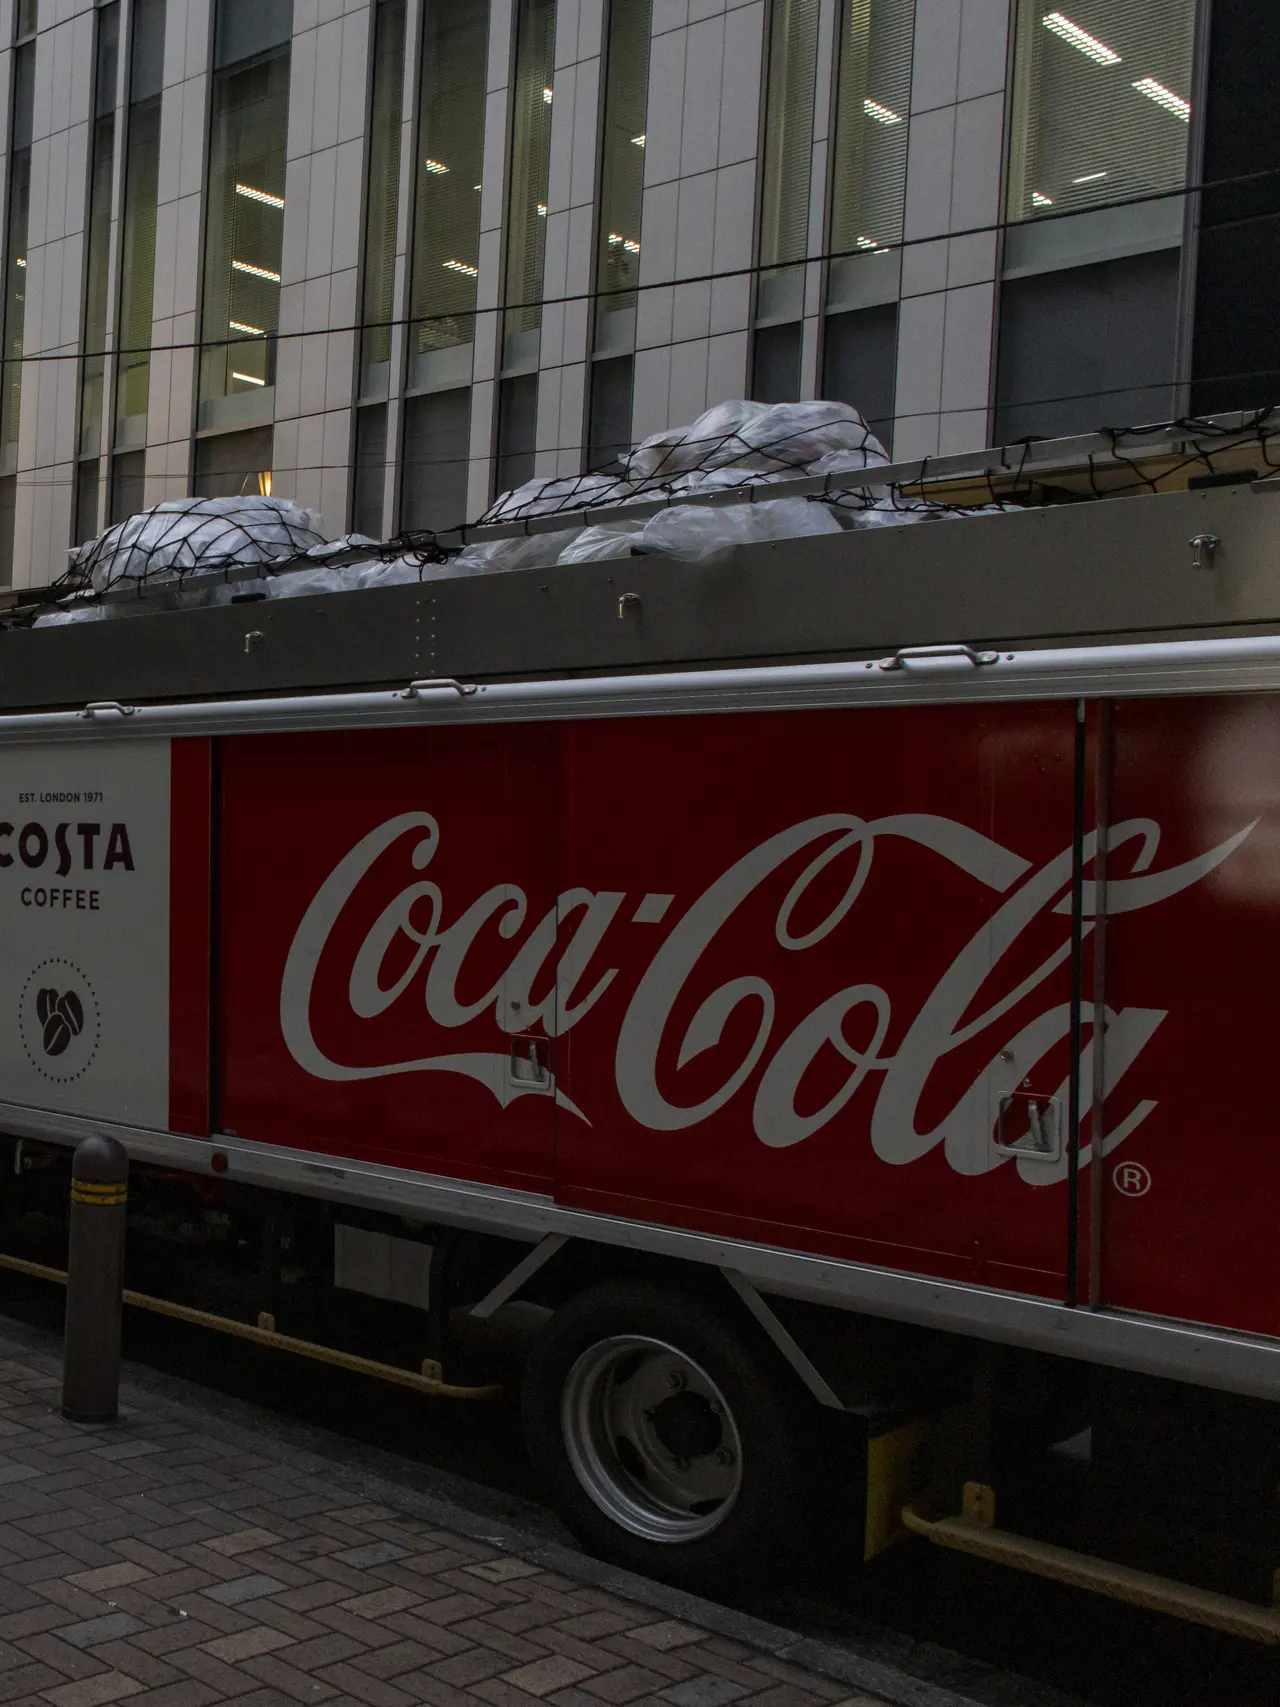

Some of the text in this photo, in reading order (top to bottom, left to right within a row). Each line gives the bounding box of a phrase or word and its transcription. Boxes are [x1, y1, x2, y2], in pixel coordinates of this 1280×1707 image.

[19, 792, 103, 803] EST. LONDON 1971
[21, 887, 100, 910] COFFEE
[280, 811, 1260, 1187] Coca-Cola
